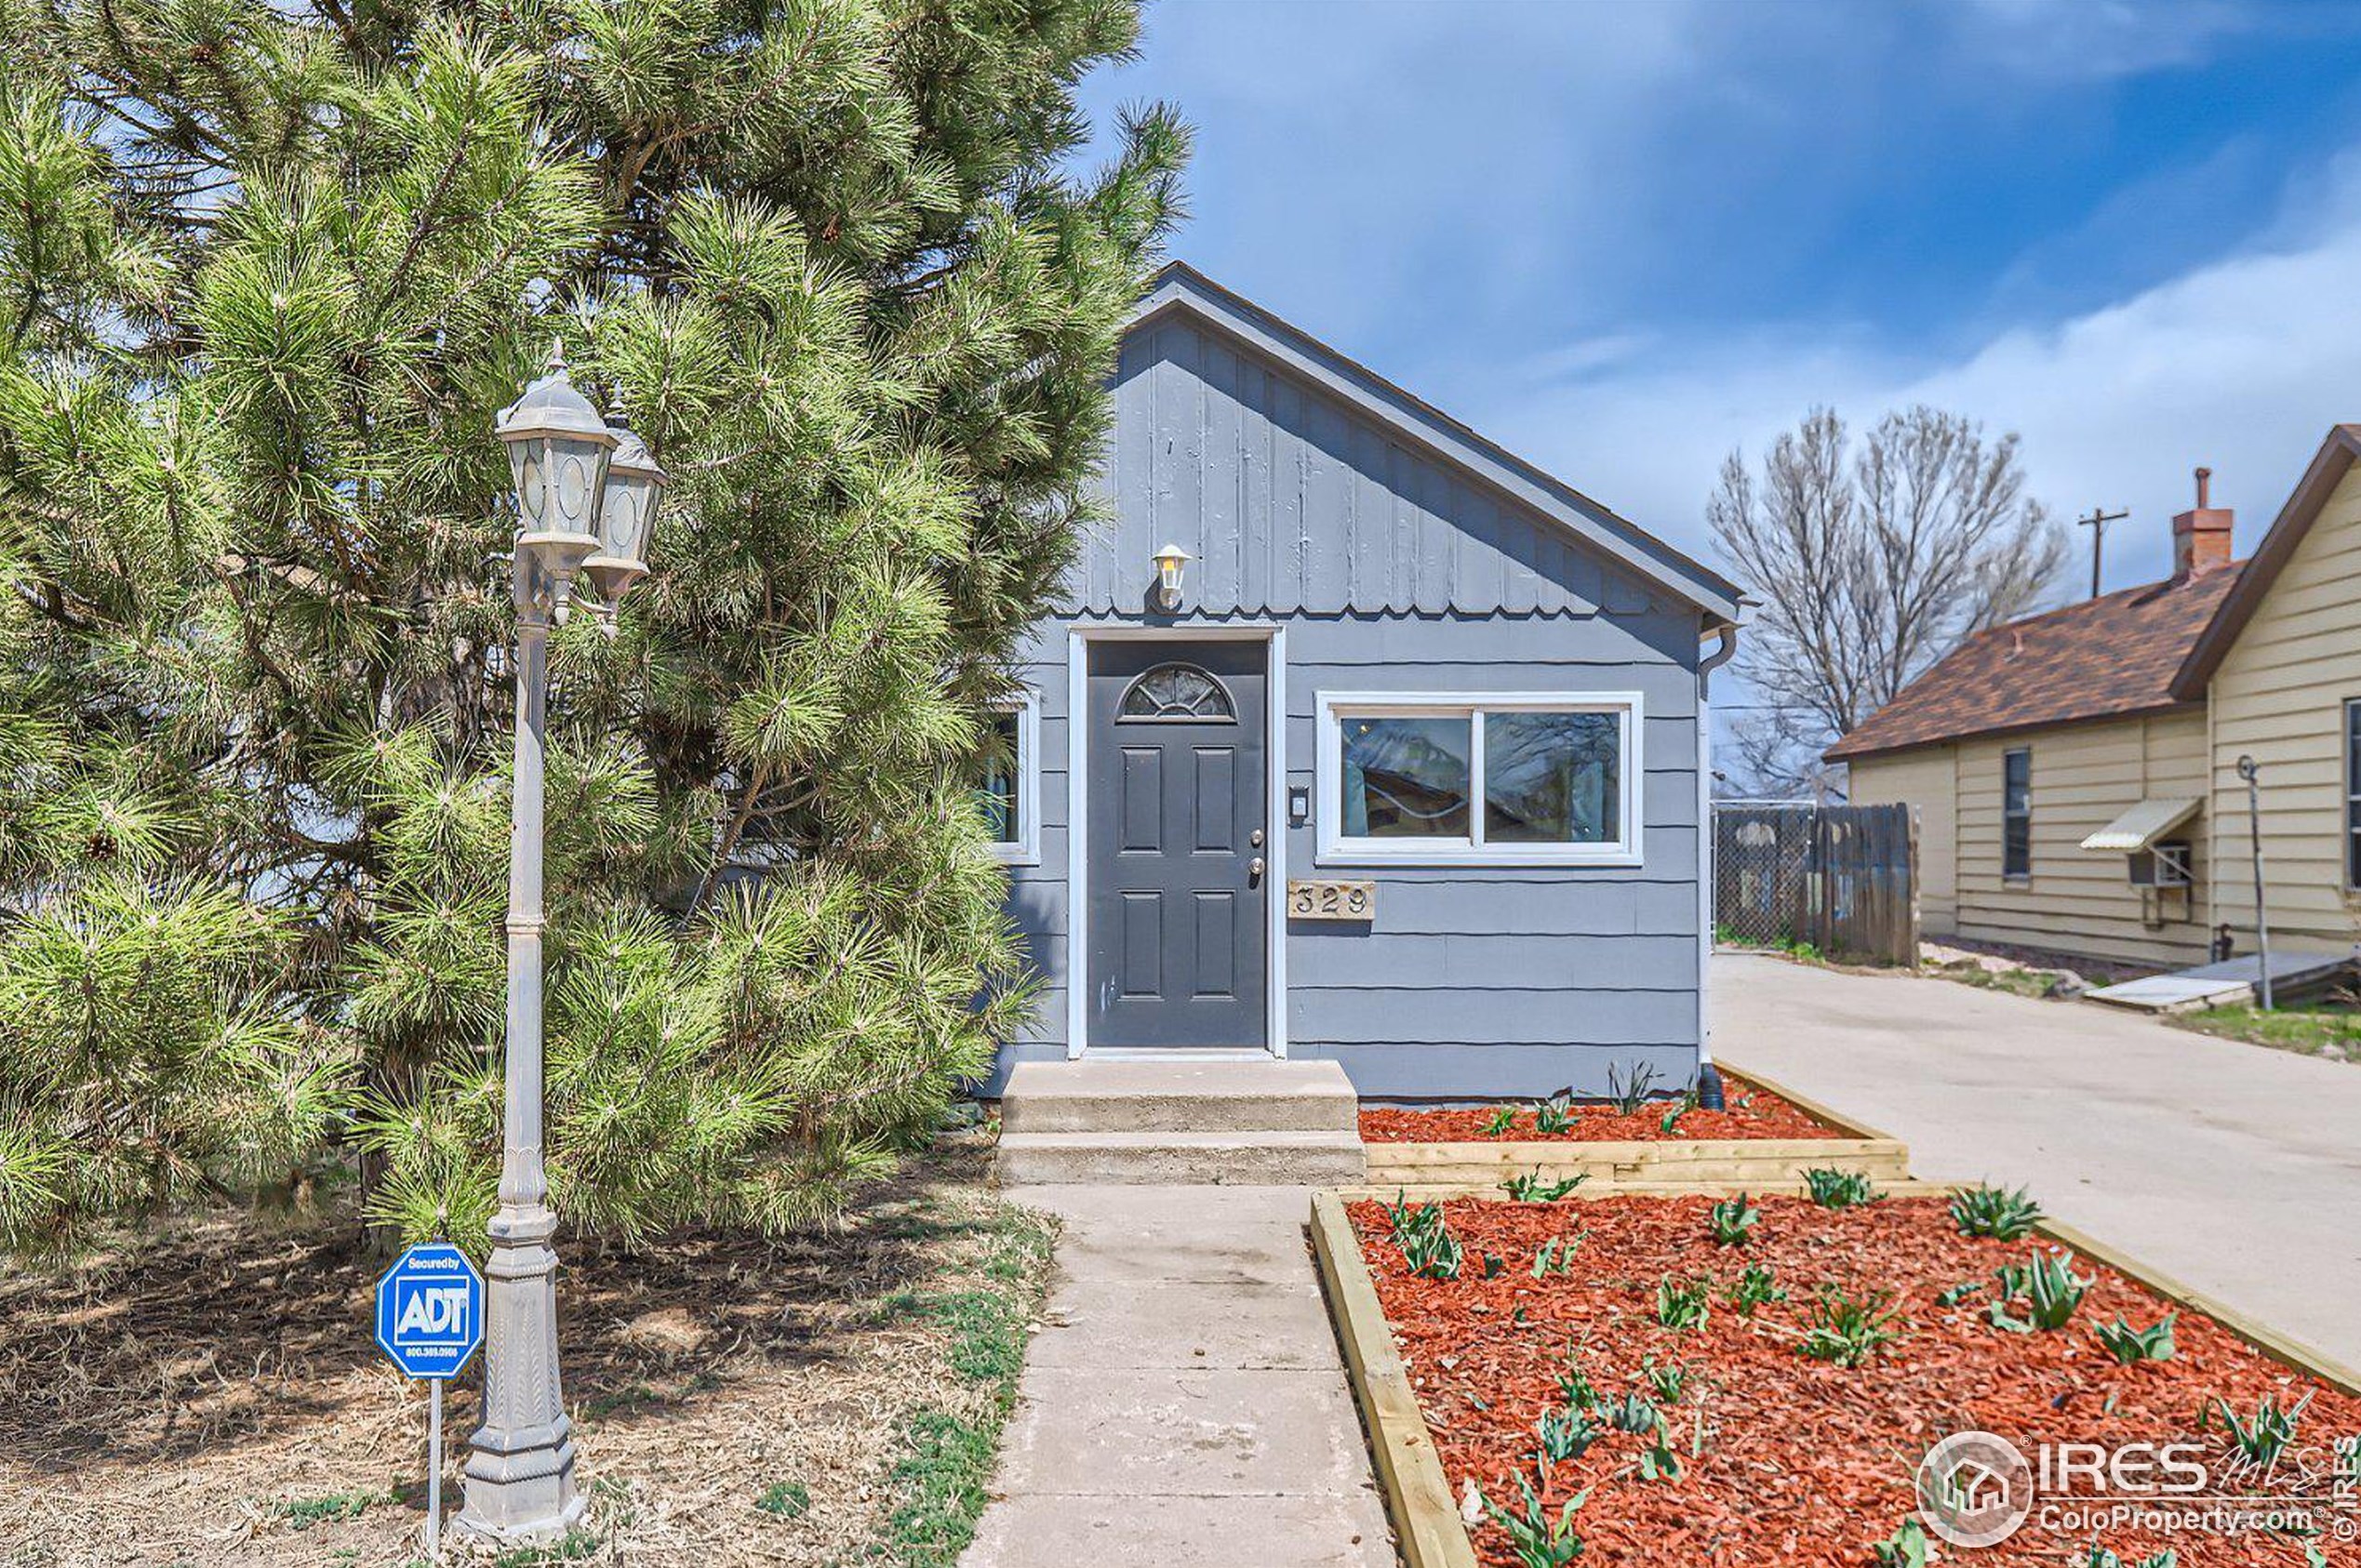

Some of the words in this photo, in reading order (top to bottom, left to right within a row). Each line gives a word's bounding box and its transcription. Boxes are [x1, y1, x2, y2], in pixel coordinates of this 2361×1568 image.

[1296, 886, 1367, 913] 329
[408, 1257, 448, 1269] Secured
[448, 1256, 460, 1271] by
[399, 1288, 467, 1334] ADT
